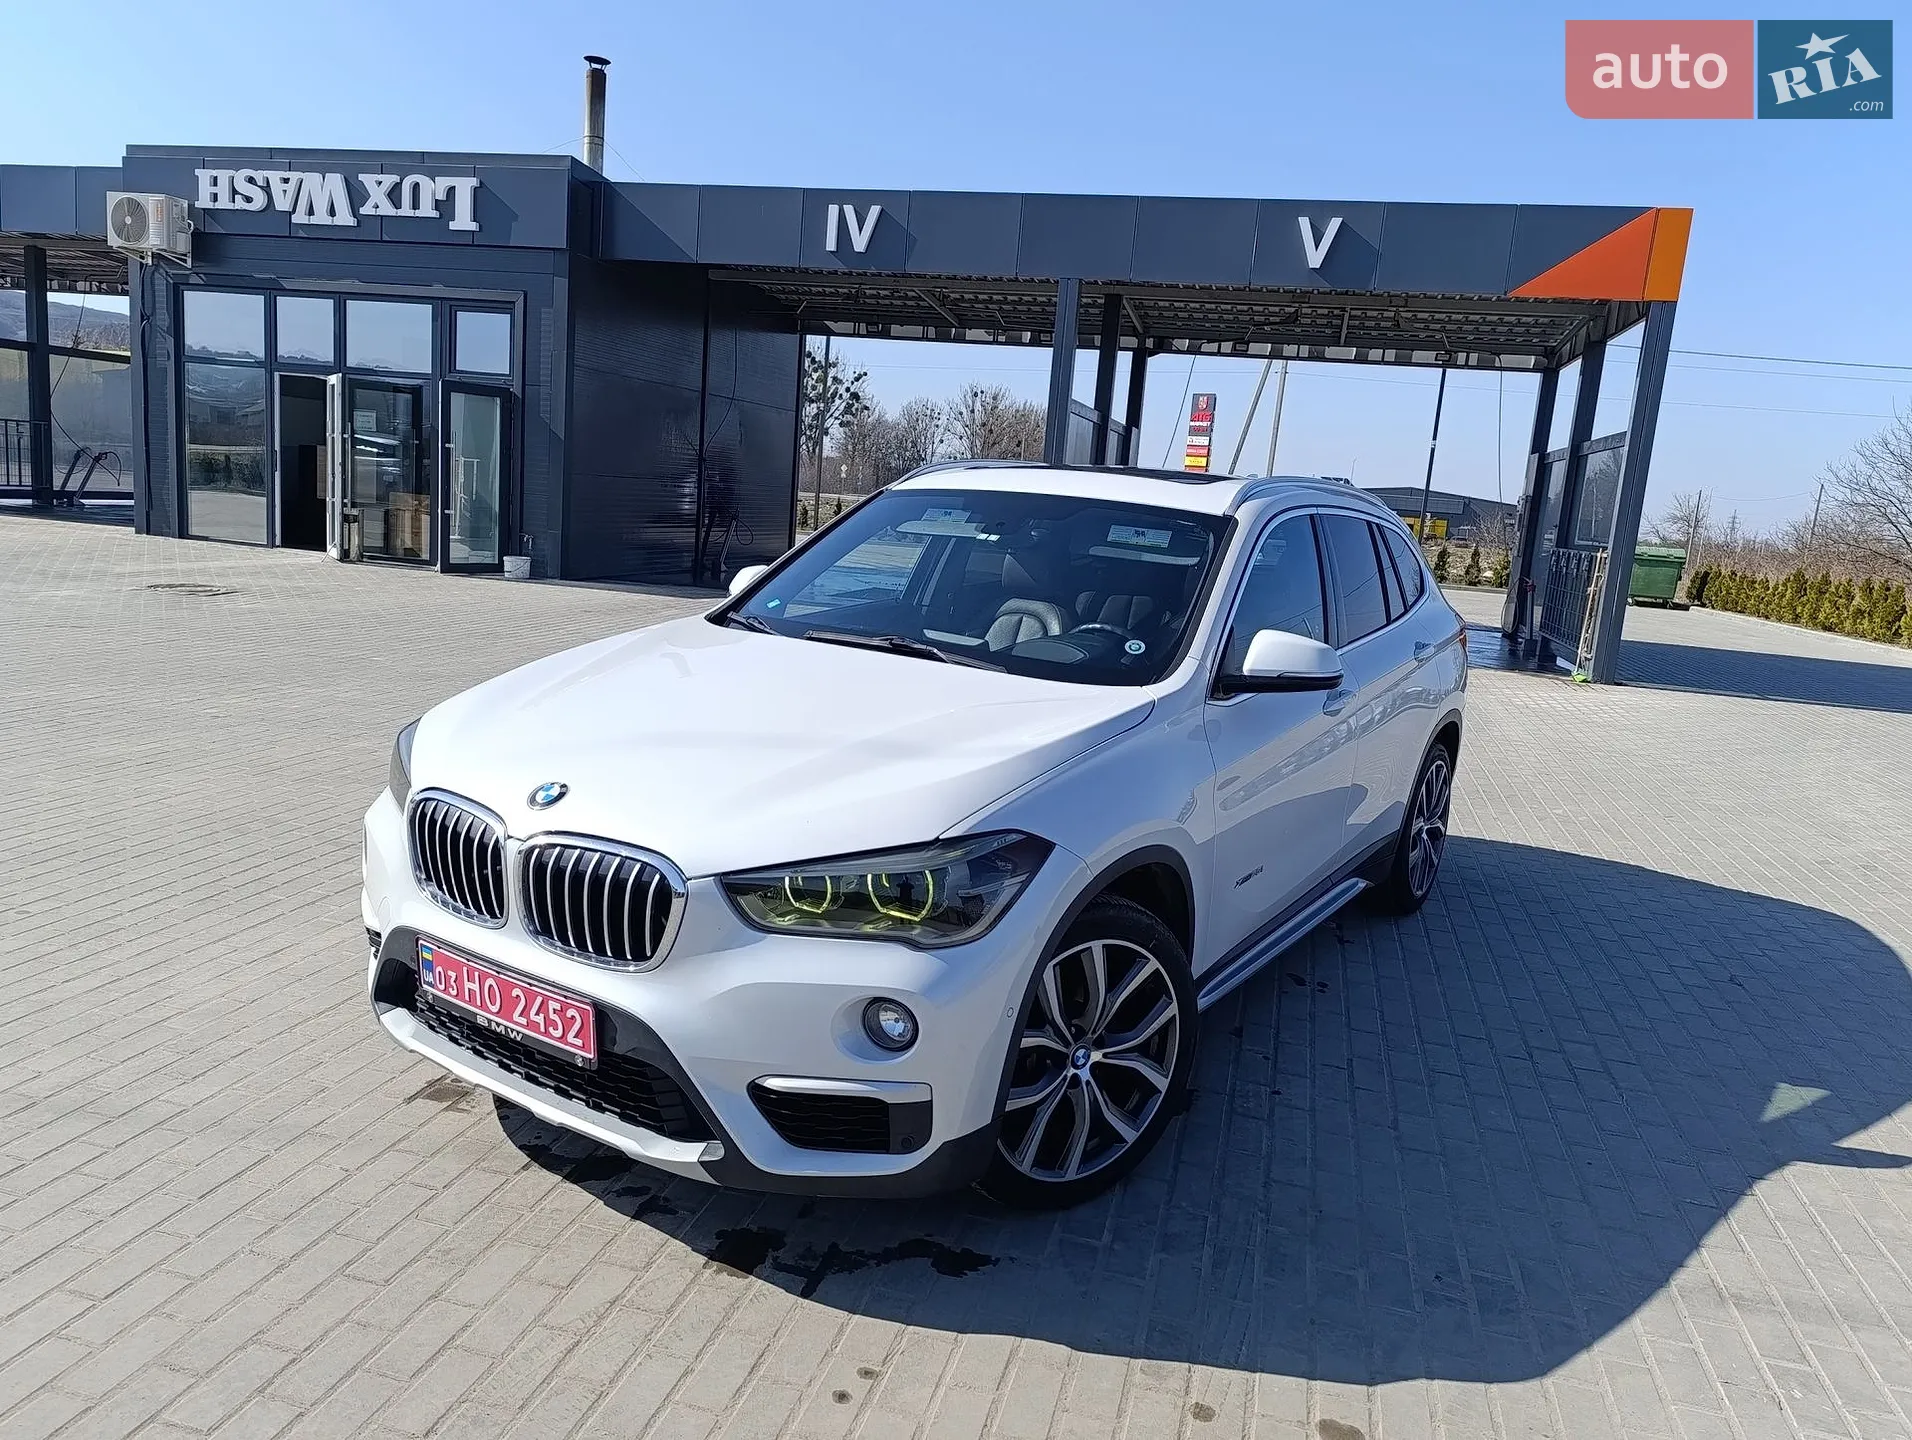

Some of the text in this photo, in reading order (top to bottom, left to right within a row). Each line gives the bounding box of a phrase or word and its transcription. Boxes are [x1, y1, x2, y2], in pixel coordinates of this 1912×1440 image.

[194, 168, 481, 232] LUX WASH
[826, 204, 882, 253] IV
[1298, 216, 1343, 269] V
[423, 969, 435, 985] UA
[435, 965, 584, 1048] 03 HO 2452
[476, 1015, 524, 1042] BMW
